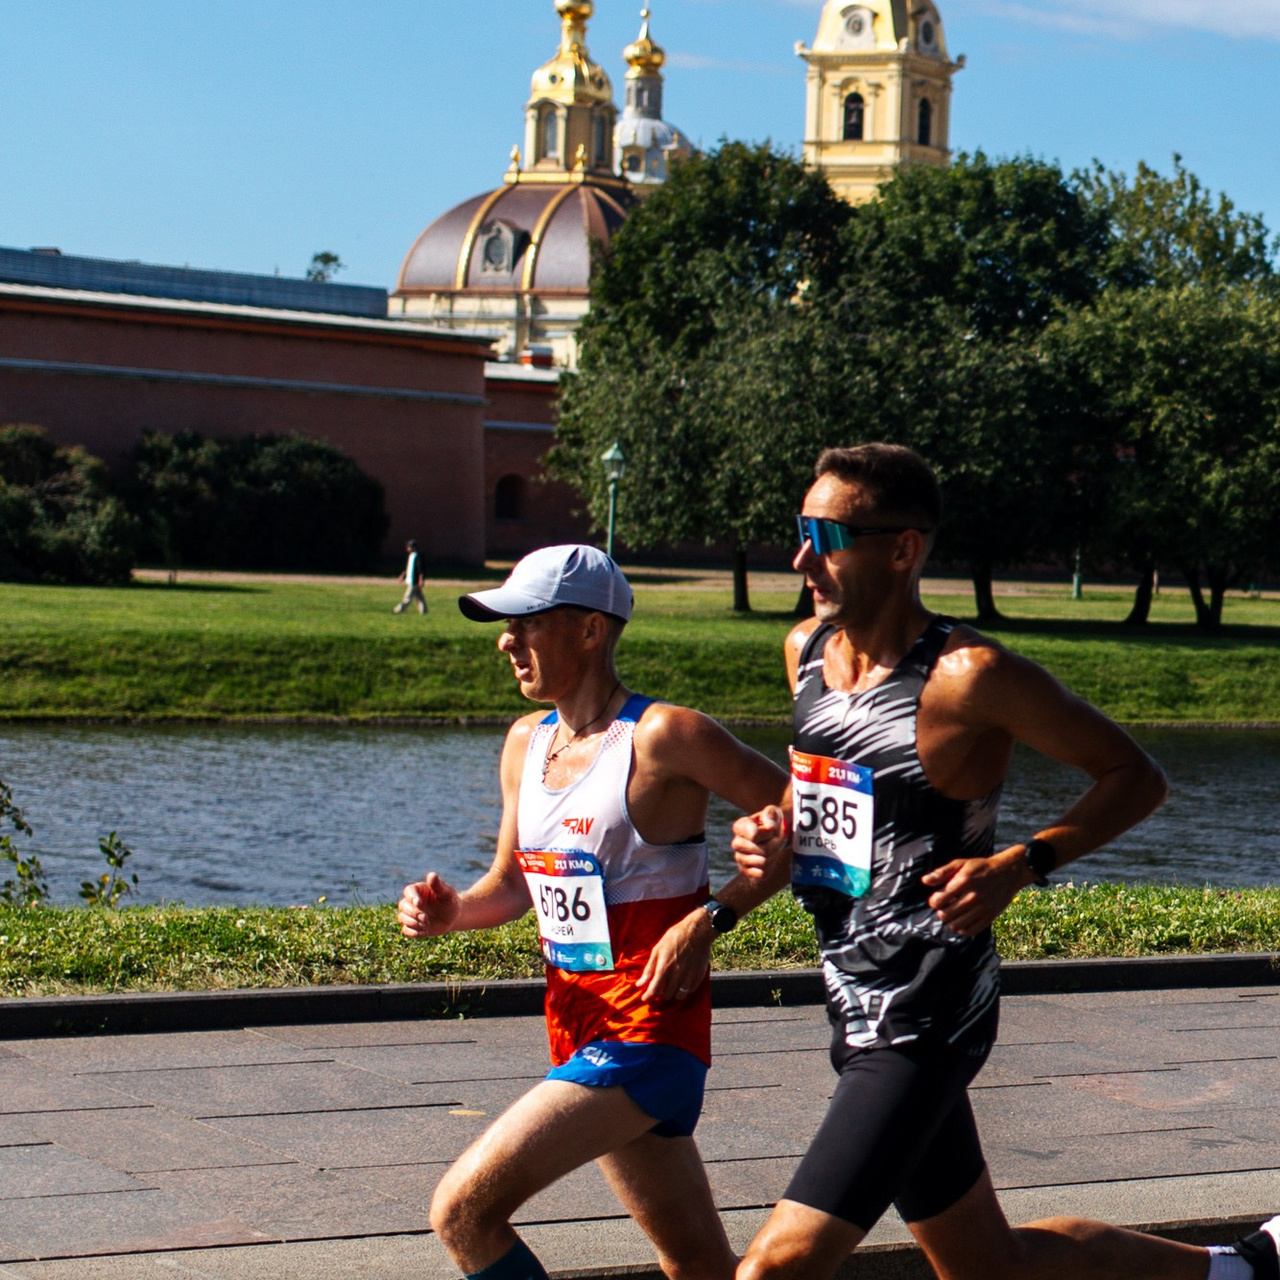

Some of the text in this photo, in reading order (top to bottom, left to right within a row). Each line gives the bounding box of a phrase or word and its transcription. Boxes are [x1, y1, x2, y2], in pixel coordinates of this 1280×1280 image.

[797, 789, 857, 840] 585
[798, 835, 837, 850] ИГОРЬ
[540, 884, 590, 922] 6786
